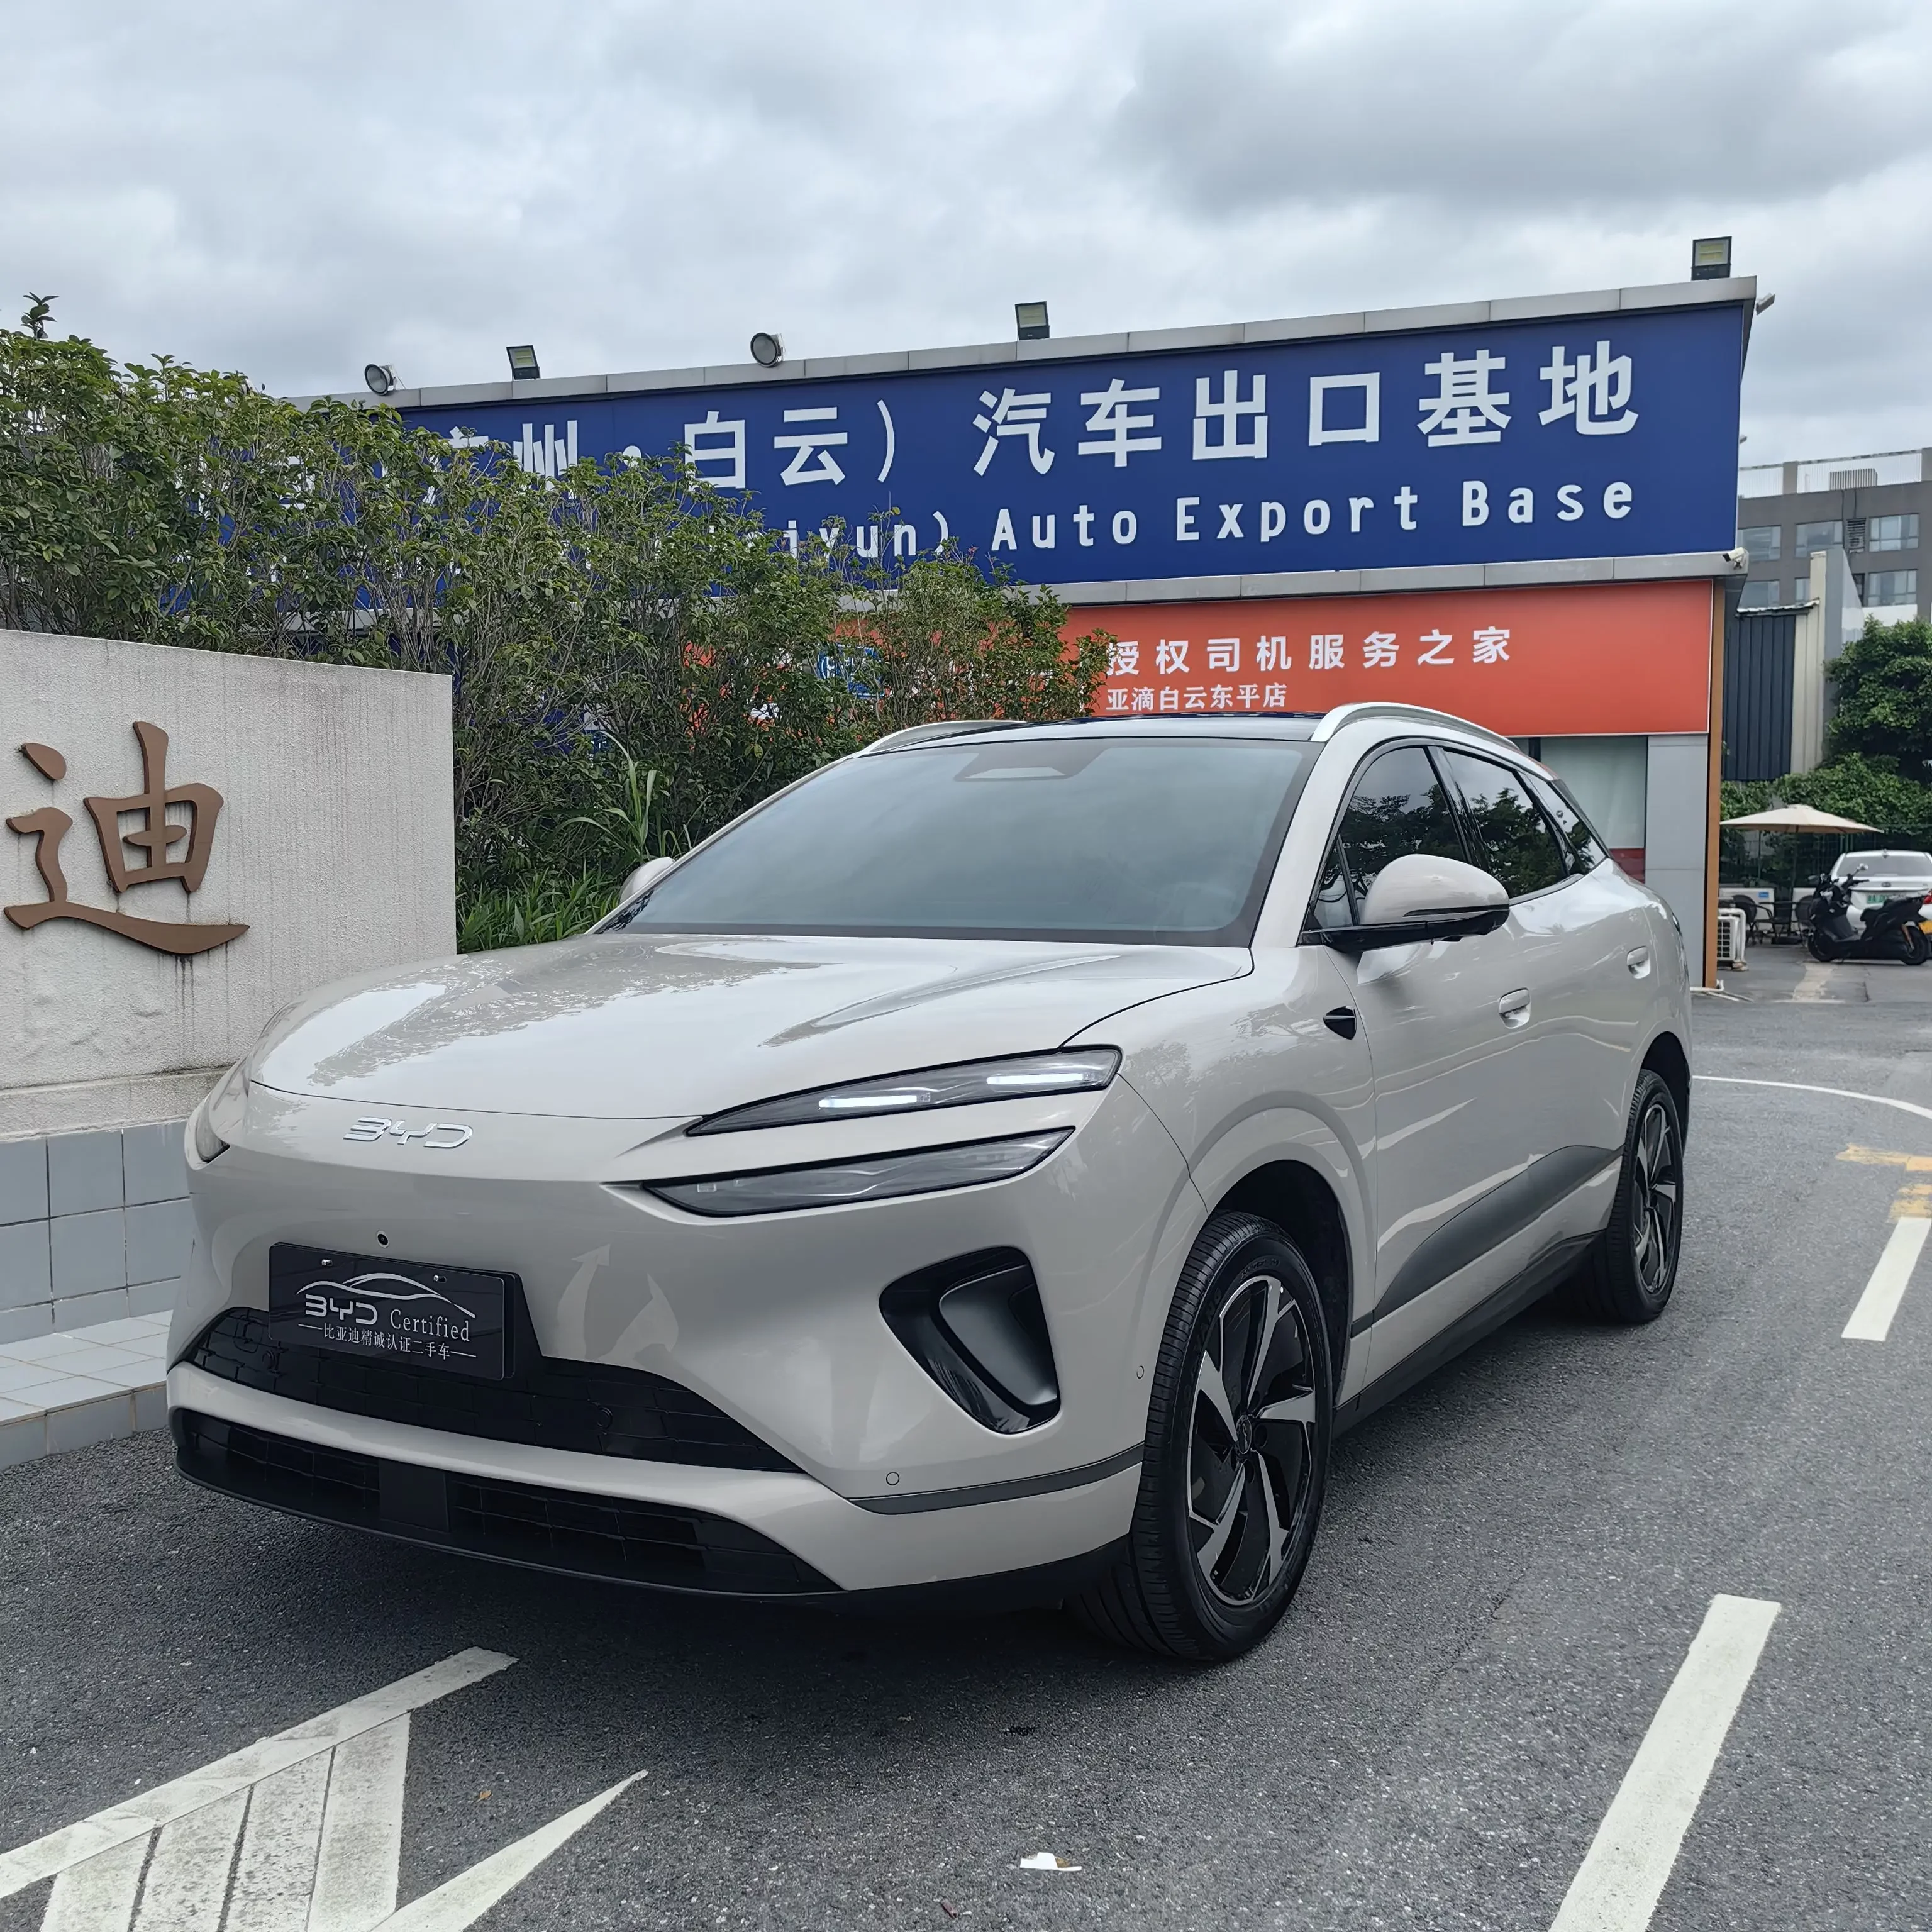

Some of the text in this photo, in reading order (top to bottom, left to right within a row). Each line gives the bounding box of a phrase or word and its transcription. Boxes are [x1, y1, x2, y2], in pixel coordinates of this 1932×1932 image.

[973, 340, 1638, 476] 汽车出口基地
[992, 505, 1137, 551] Auto
[1177, 486, 1418, 542] Export
[1462, 481, 1632, 526] Base
[1106, 626, 1511, 676] 授权司机服务之家
[1106, 683, 1287, 711] 亚滴白云东平店
[4, 721, 250, 955] 迪
[343, 1116, 473, 1148] BYD
[305, 1293, 470, 1341] BYD Certified
[323, 1323, 451, 1360] 比亚迪精诚认证二手车
